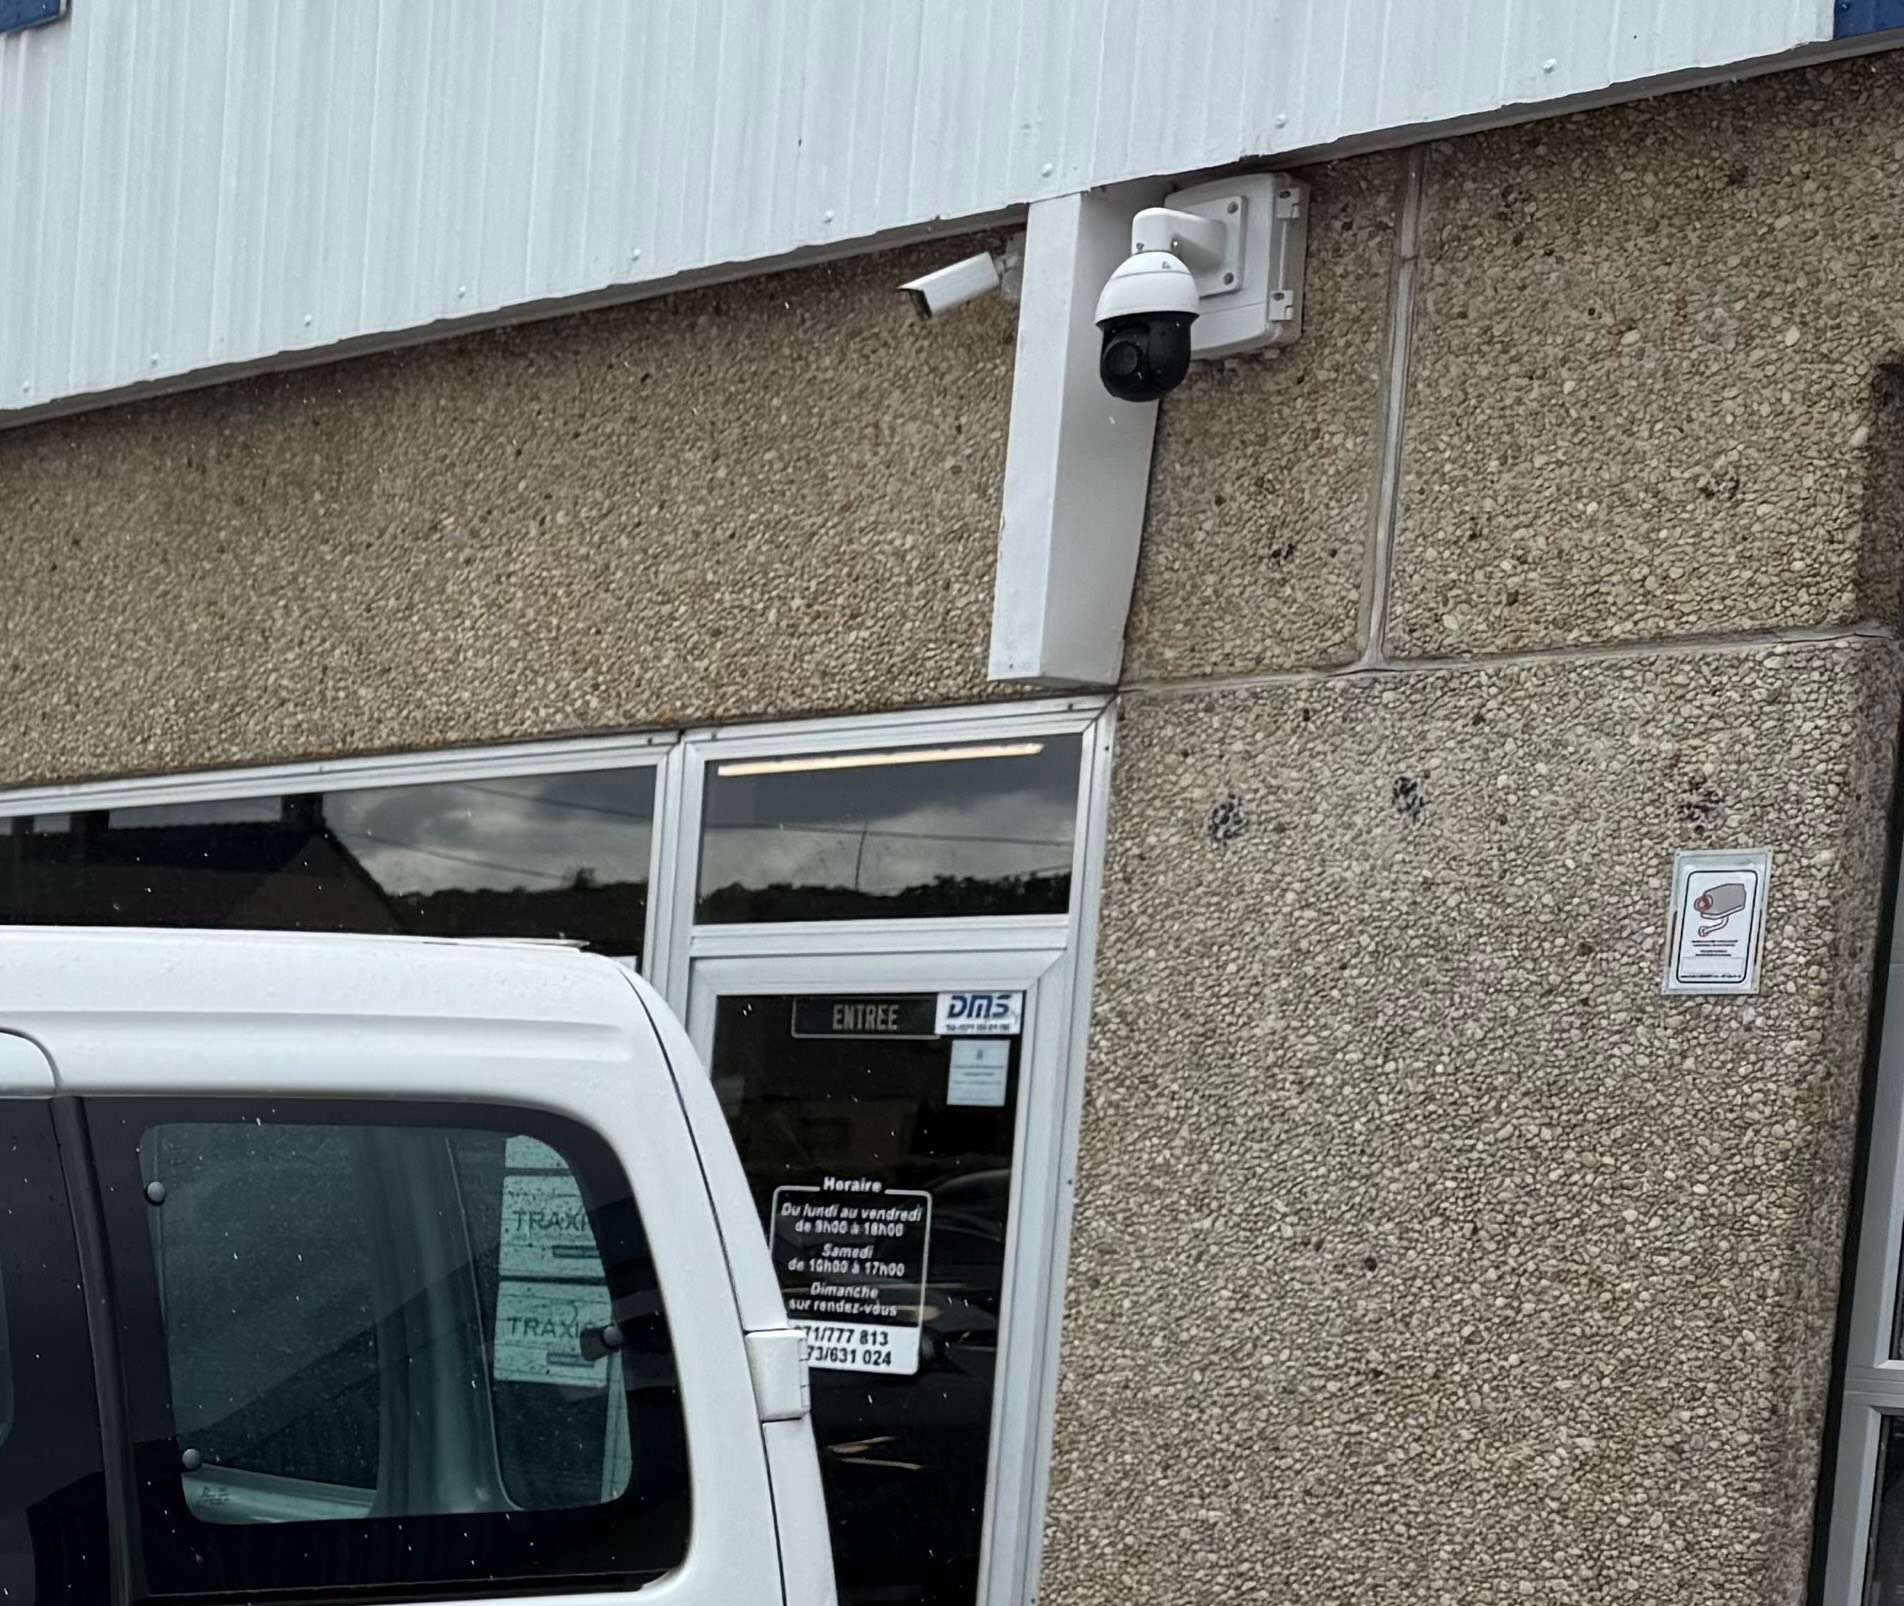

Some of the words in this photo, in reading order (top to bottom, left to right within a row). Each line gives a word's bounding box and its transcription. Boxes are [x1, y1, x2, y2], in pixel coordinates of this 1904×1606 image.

[947, 994, 1012, 1019] DMS
[823, 1176, 882, 1193] Horaire
[781, 1202, 801, 1216] Du
[803, 1203, 840, 1218] lundi
[840, 1207, 857, 1219] au
[861, 1205, 923, 1222] vendredi
[795, 1220, 811, 1232] de
[822, 1243, 874, 1259] Samedi
[788, 1258, 804, 1271] de
[864, 1261, 905, 1277] 17h00
[810, 1282, 879, 1299] Dimanche
[789, 1299, 811, 1310] sur
[813, 1300, 897, 1317] rendez-vous
[507, 1316, 596, 1338] TRAXI
[794, 1325, 855, 1344] 71/777
[859, 1330, 889, 1346] 813
[863, 1350, 891, 1366] 024
